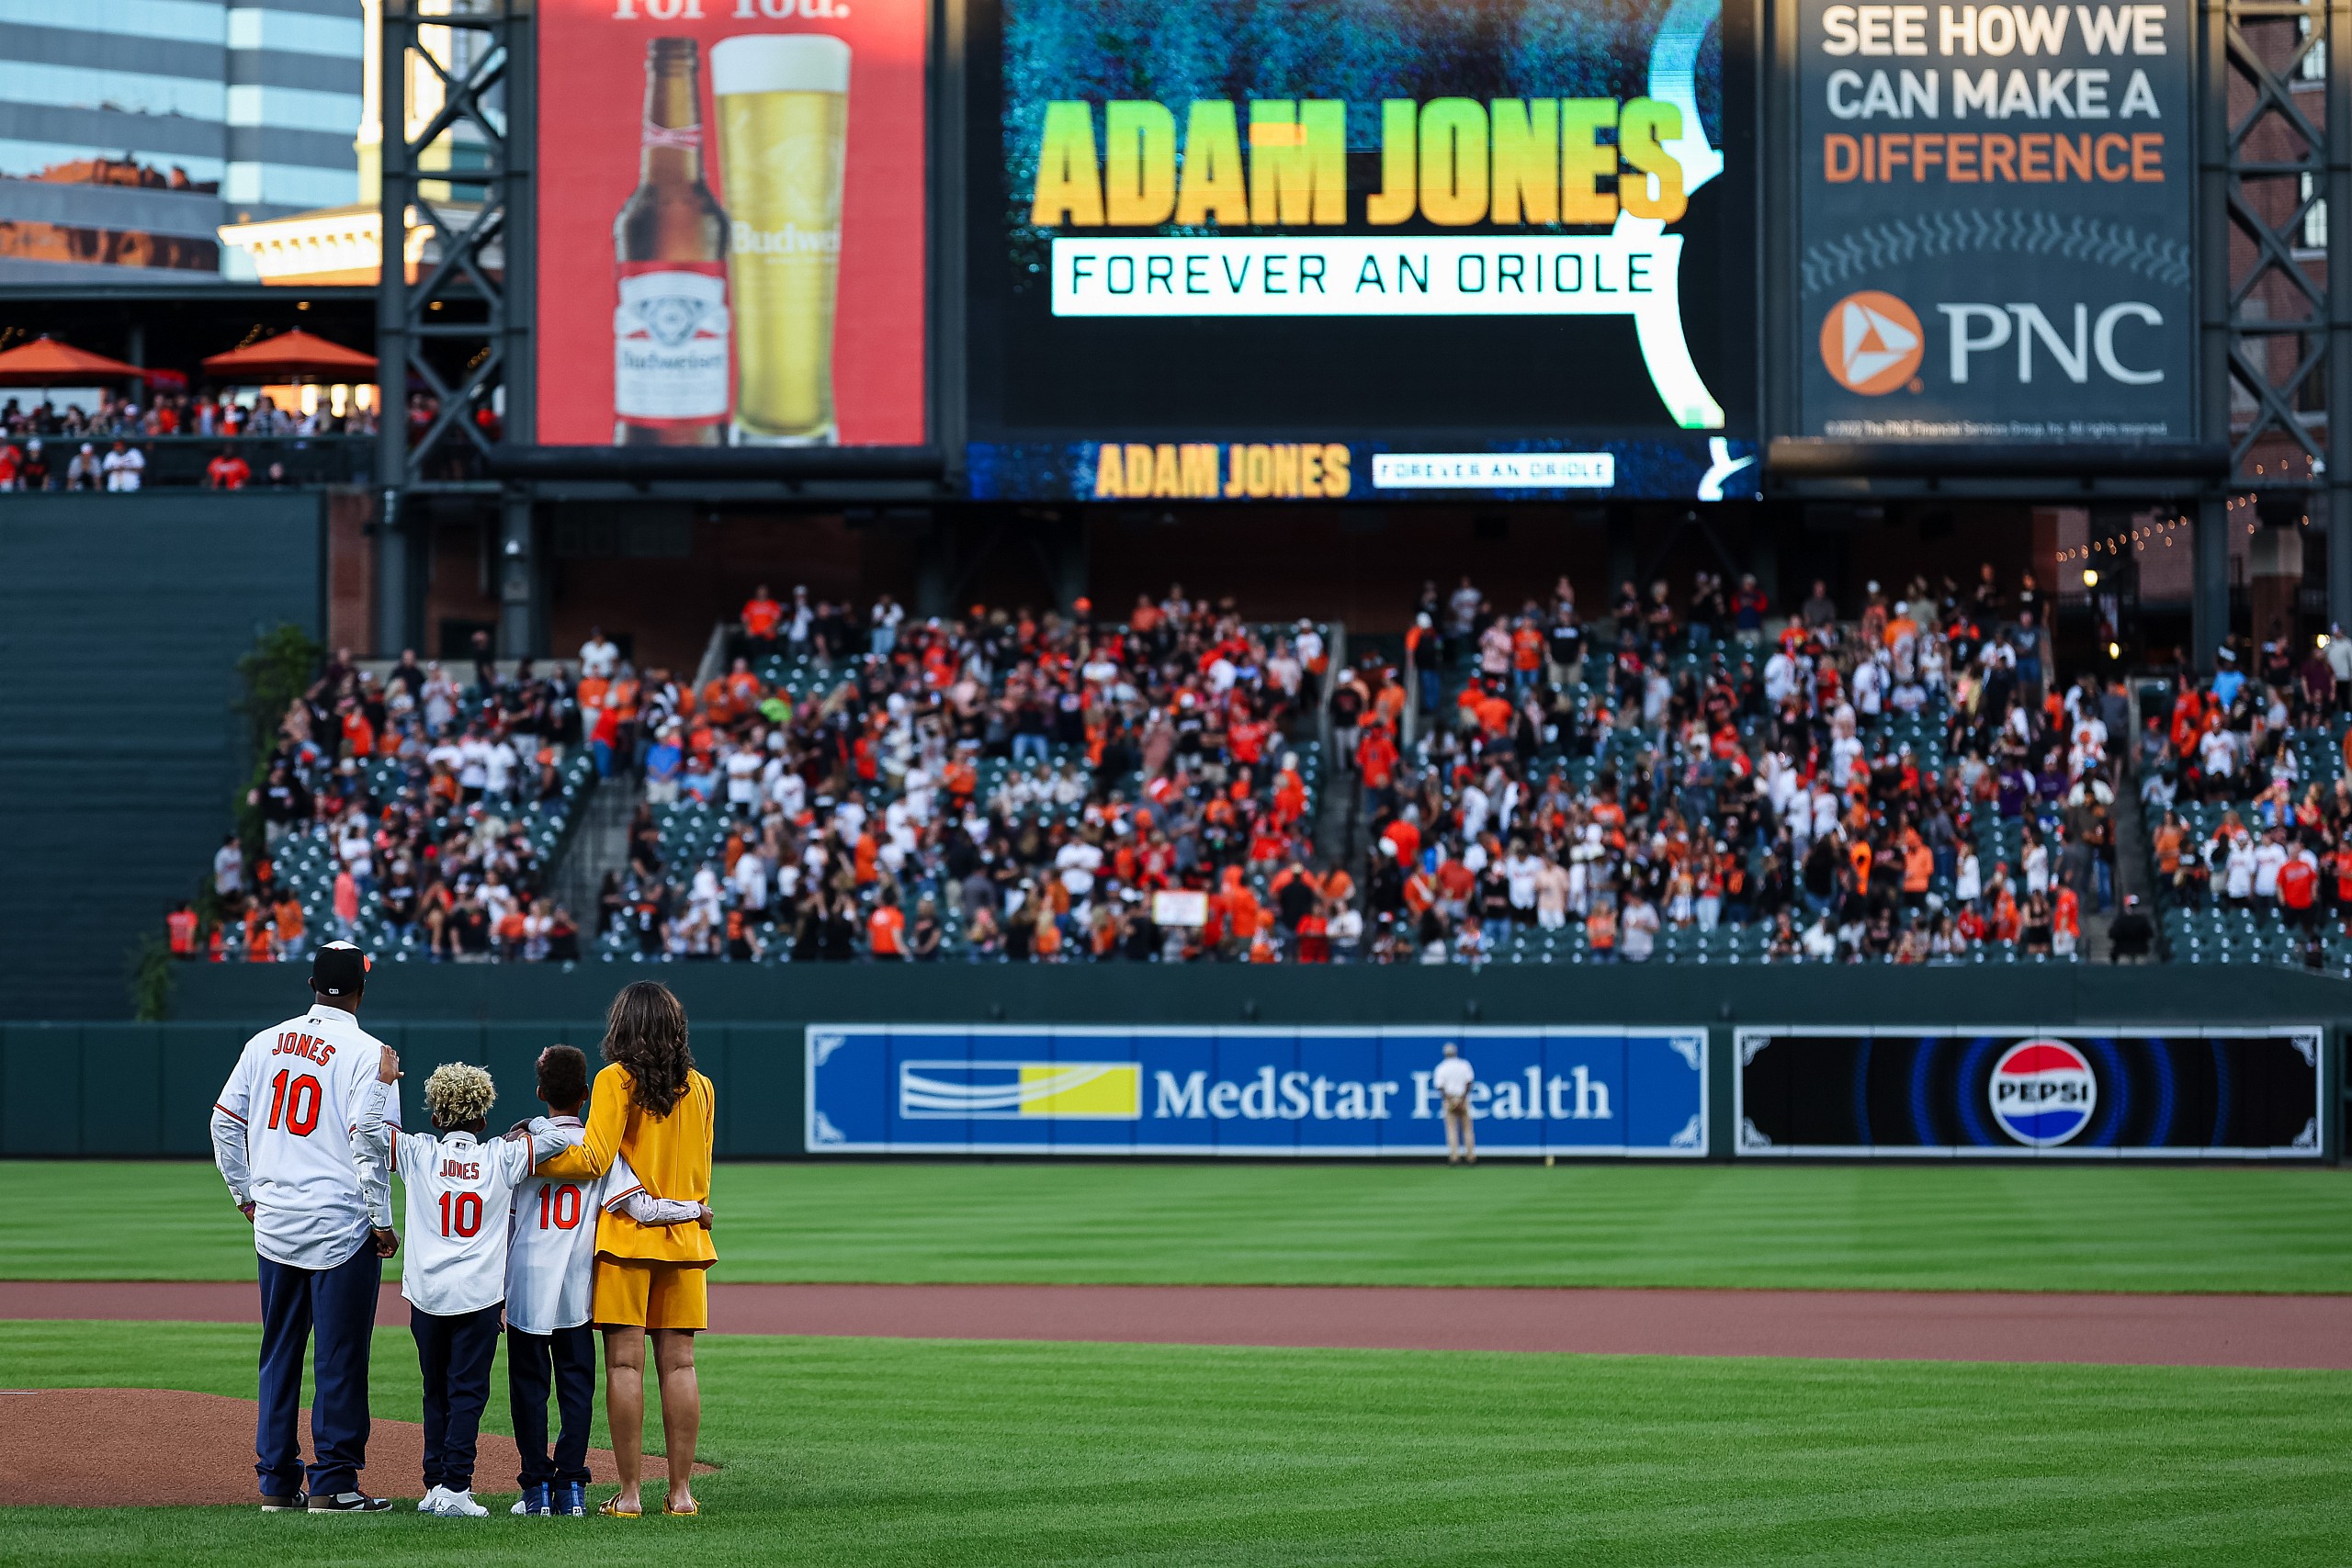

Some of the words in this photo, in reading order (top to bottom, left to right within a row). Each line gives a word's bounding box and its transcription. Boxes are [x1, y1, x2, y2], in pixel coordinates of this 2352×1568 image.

[1821, 5, 1928, 56] SEE
[1939, 5, 2072, 57] HOW
[2077, 4, 2167, 56] WE
[1826, 69, 1939, 119] CAN
[1952, 68, 2110, 119] MAKE
[2120, 69, 2161, 118] A
[1031, 99, 1347, 227] ADAM
[1367, 96, 1690, 227] JONES
[1824, 133, 2165, 182] DIFFERENCE
[1071, 254, 1327, 295] FOREVER
[1355, 254, 1430, 295] AN
[1457, 253, 1654, 294] ORIOLE
[1937, 302, 2165, 384] PNC
[1096, 444, 1219, 498] ADAM
[1225, 444, 1351, 498] JONES
[1381, 463, 1480, 477] FOREVER
[1491, 463, 1521, 477] AN
[1530, 462, 1604, 477] OROLE
[272, 1032, 336, 1066] JONES
[267, 1068, 322, 1137] 10
[1155, 1065, 1399, 1120] MedStar
[1998, 1081, 2088, 1103] PEPSI
[439, 1158, 480, 1180] JONES
[438, 1190, 483, 1238] 10
[538, 1182, 582, 1230] 10
